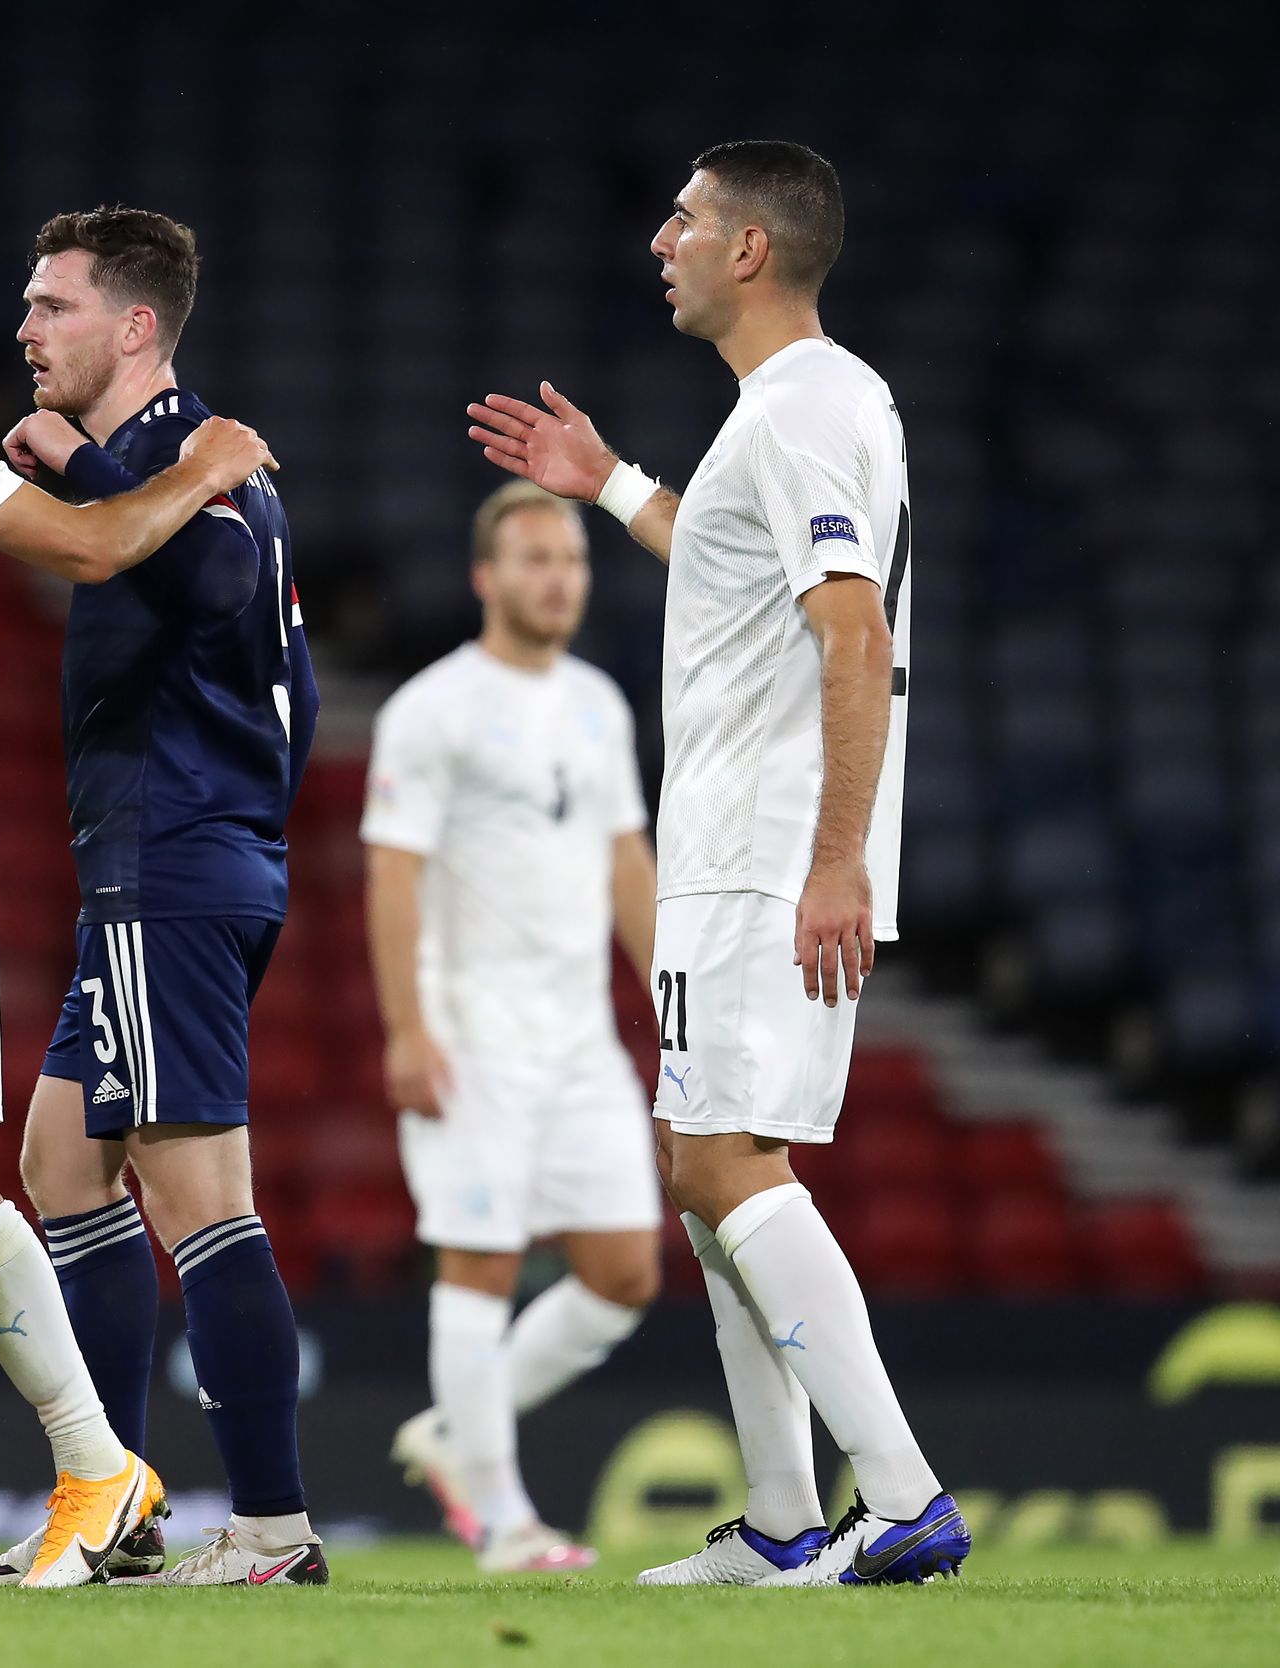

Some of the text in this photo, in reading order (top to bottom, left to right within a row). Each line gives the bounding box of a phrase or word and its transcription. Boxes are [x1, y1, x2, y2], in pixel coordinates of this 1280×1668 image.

[813, 521, 855, 536] RESPEC
[80, 976, 117, 1064] 3
[658, 969, 688, 1052] 21
[92, 1088, 131, 1104] adidas
